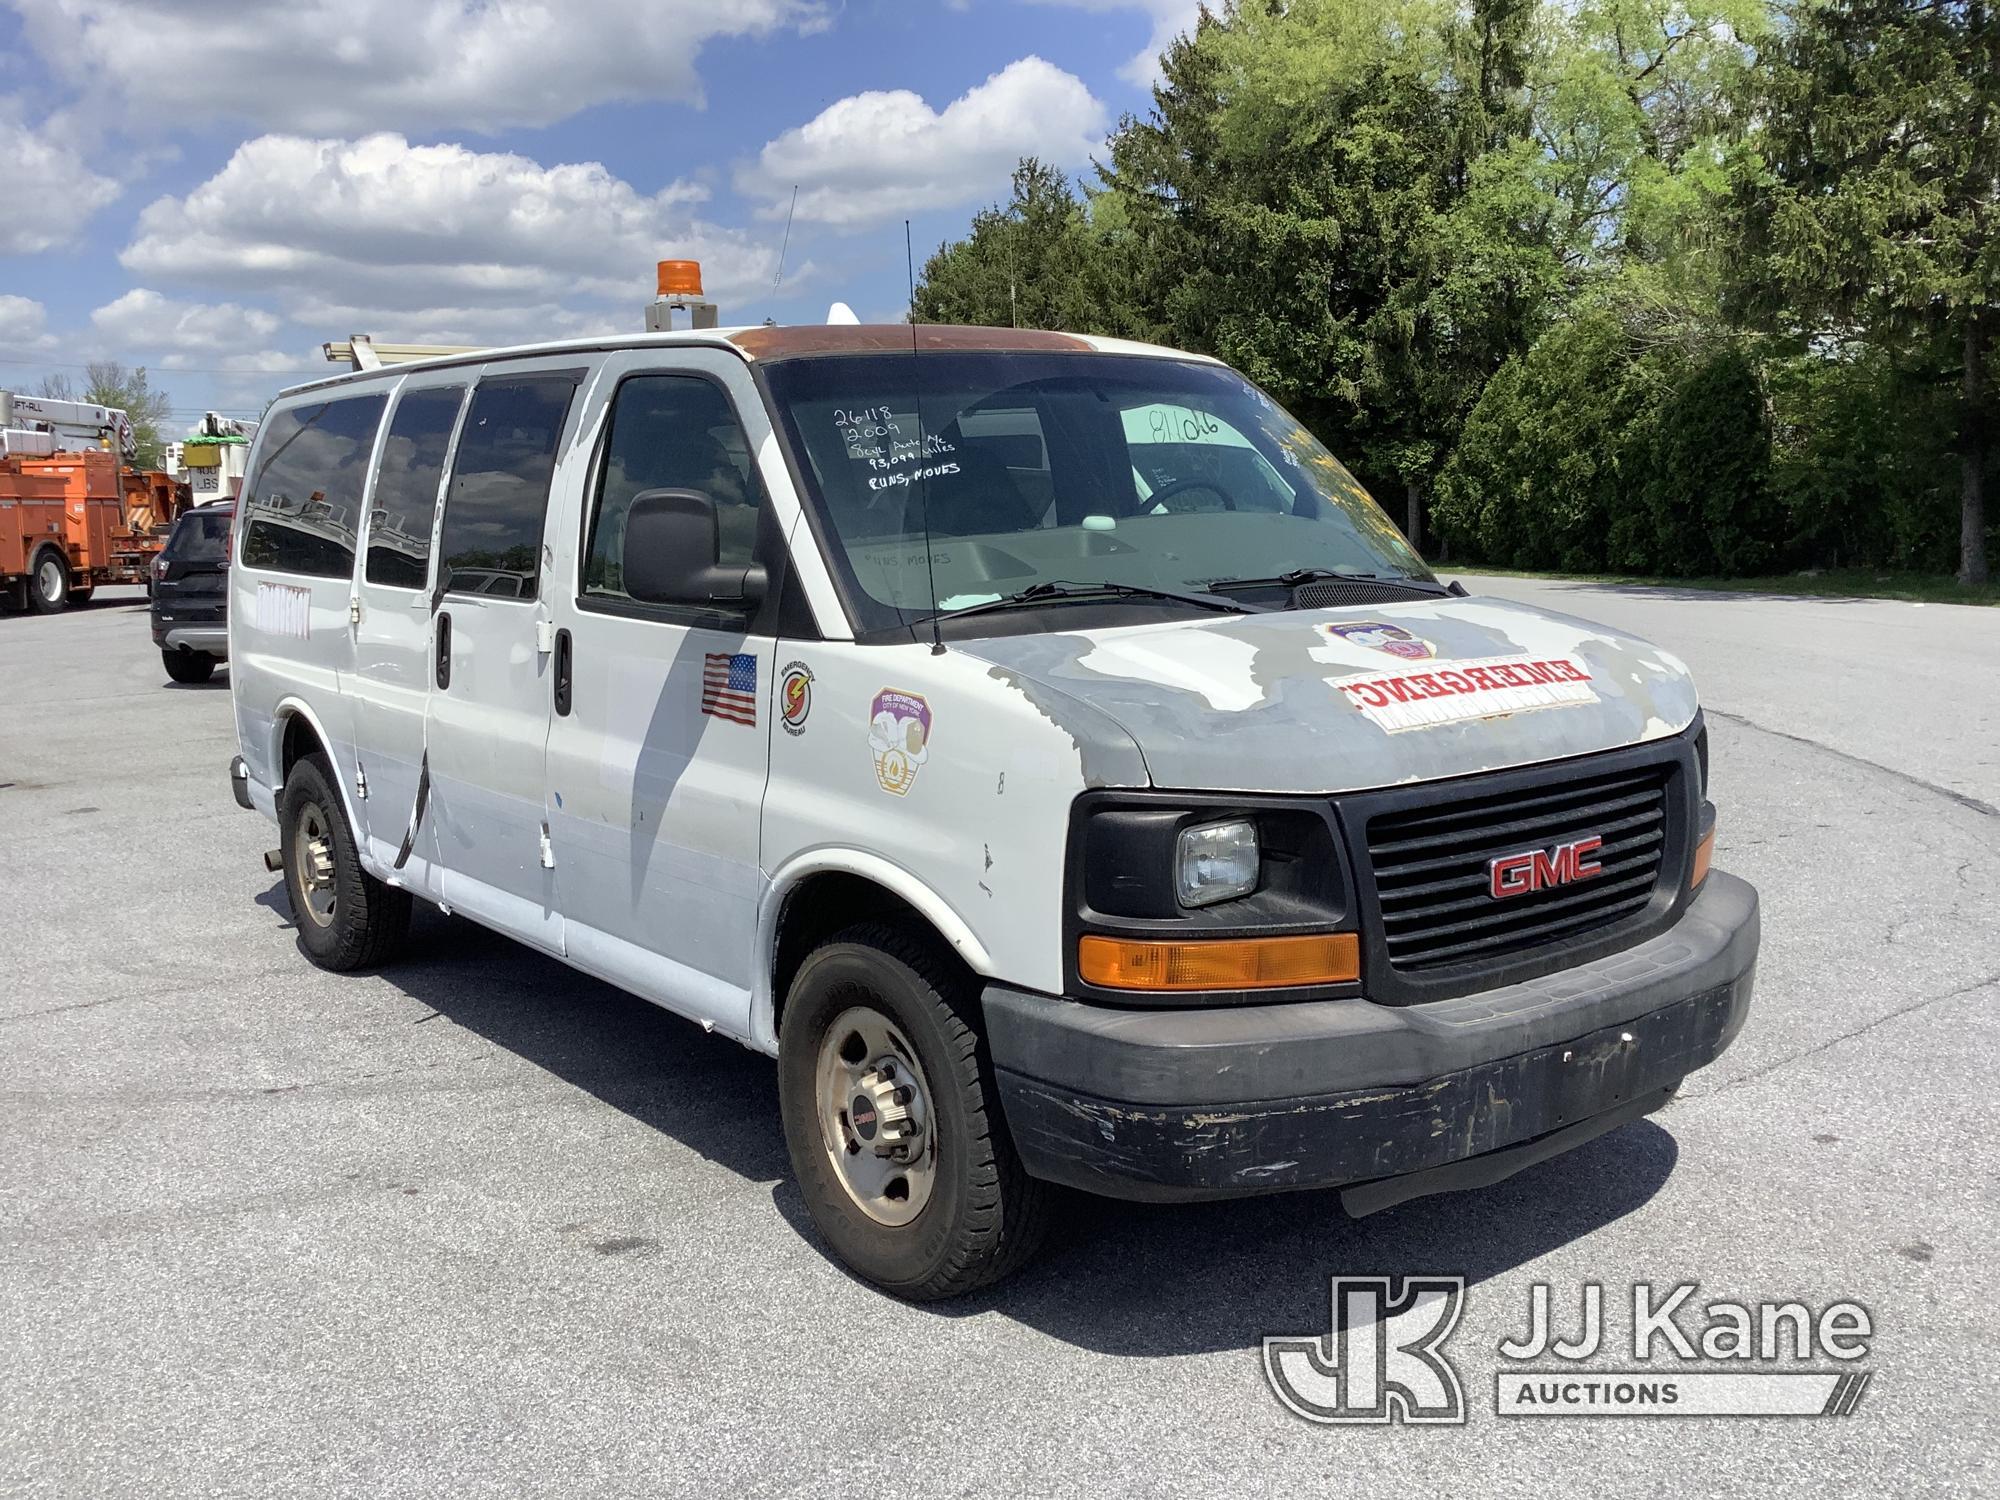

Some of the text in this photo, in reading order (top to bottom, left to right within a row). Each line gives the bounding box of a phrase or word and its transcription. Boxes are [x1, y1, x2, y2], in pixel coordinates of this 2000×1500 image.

[834, 406, 892, 426] 26118
[847, 423, 900, 441] 2009
[869, 452, 914, 470] 93,099
[914, 463, 960, 480] MOVES
[780, 660, 816, 682] EMERGENCY
[881, 694, 925, 712] FIRE DEPARTMENT
[782, 721, 806, 737] BUREAU
[1490, 835, 1602, 899] GMC
